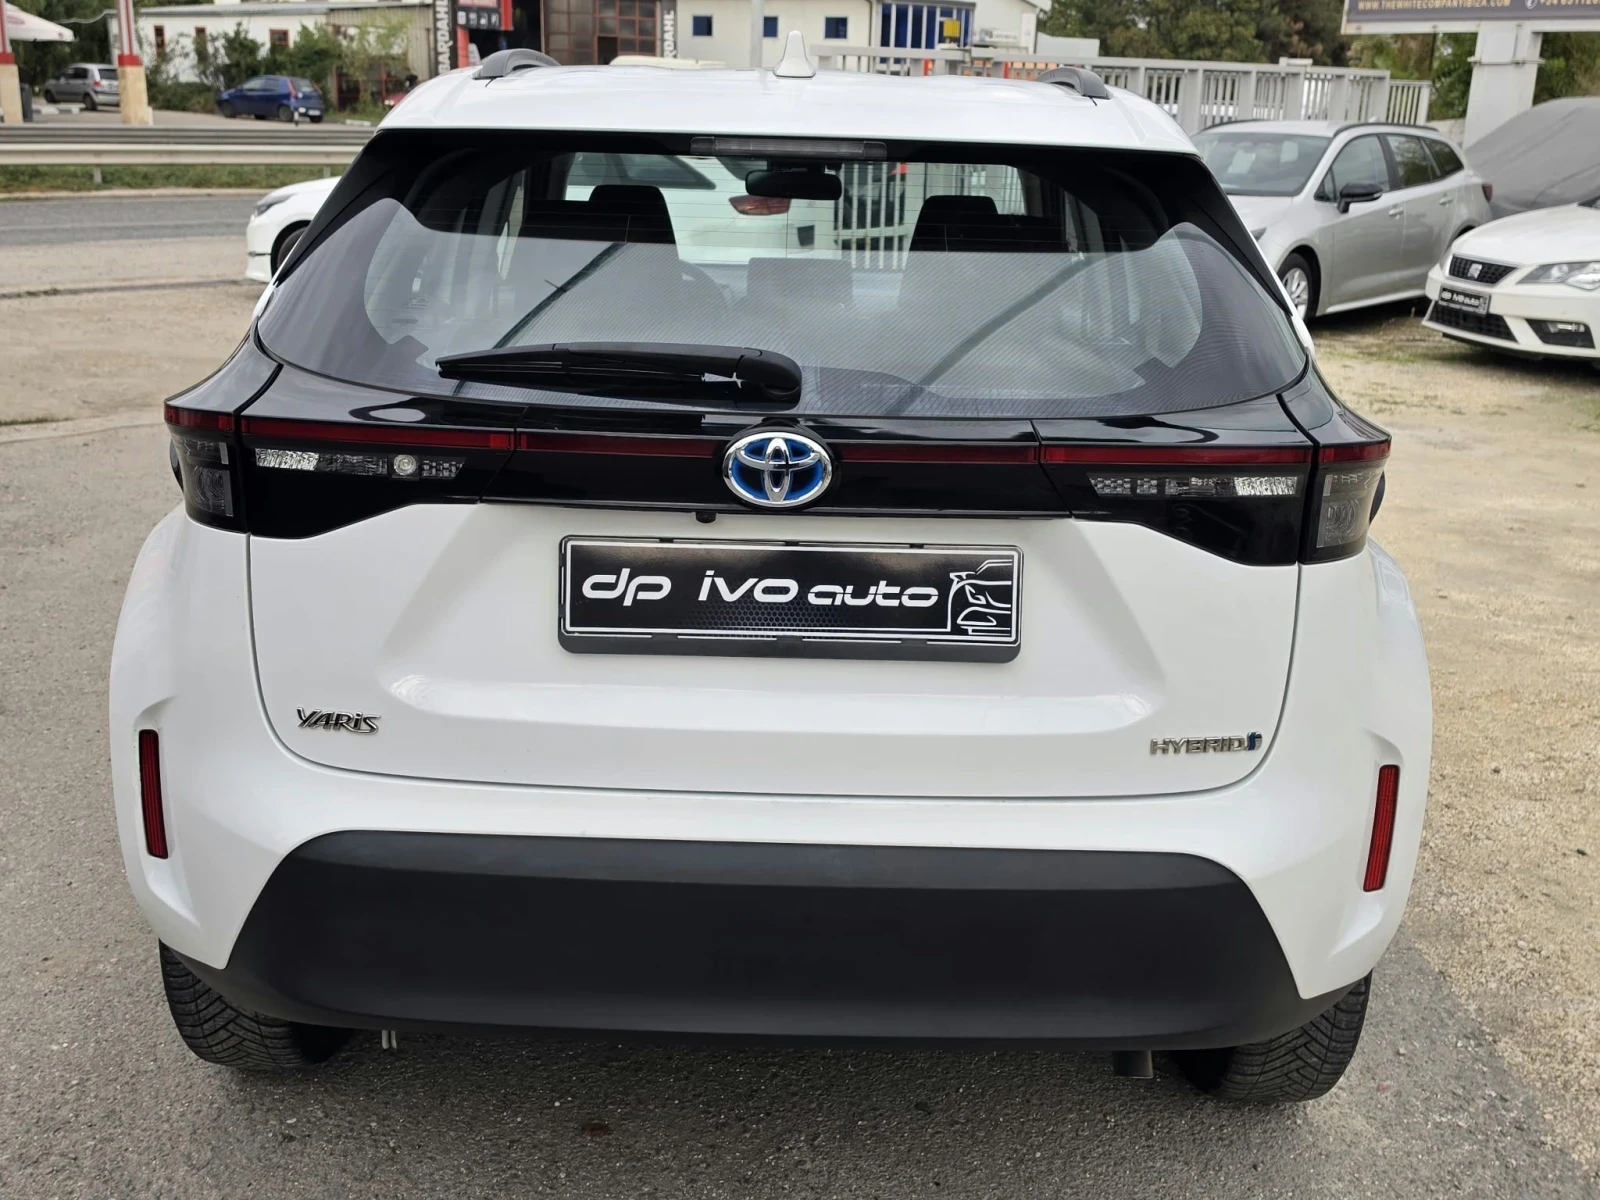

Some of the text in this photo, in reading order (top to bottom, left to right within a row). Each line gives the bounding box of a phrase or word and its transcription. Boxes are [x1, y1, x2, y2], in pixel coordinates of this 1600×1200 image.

[663, 10, 677, 59] RDAHL
[582, 568, 939, 608] dp ivo auto
